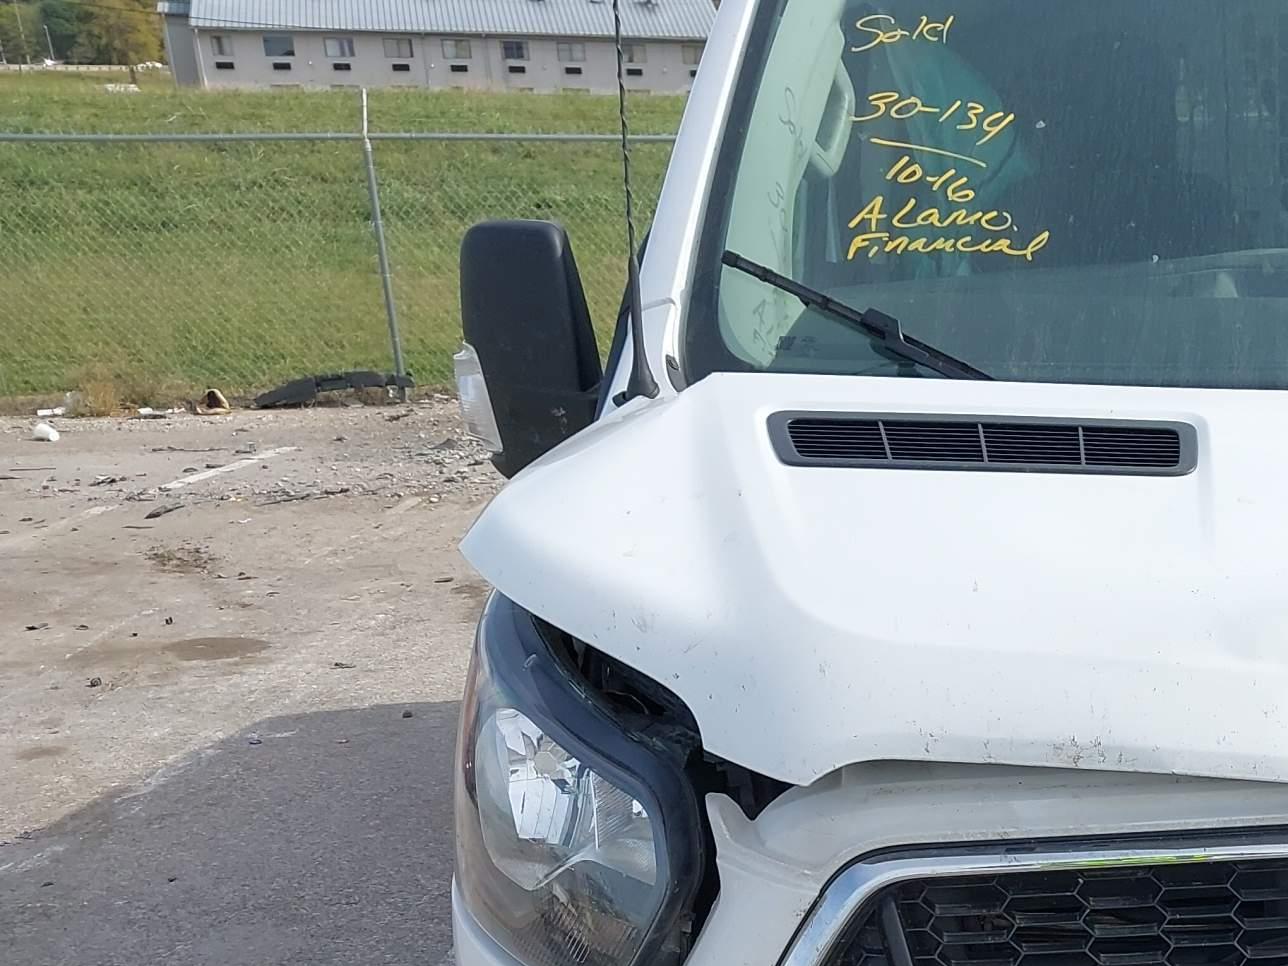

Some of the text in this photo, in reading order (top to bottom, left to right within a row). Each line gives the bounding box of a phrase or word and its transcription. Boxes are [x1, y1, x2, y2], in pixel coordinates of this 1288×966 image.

[851, 14, 954, 52] Sold
[885, 155, 976, 202] 10-16
[847, 230, 1050, 262] Financial
